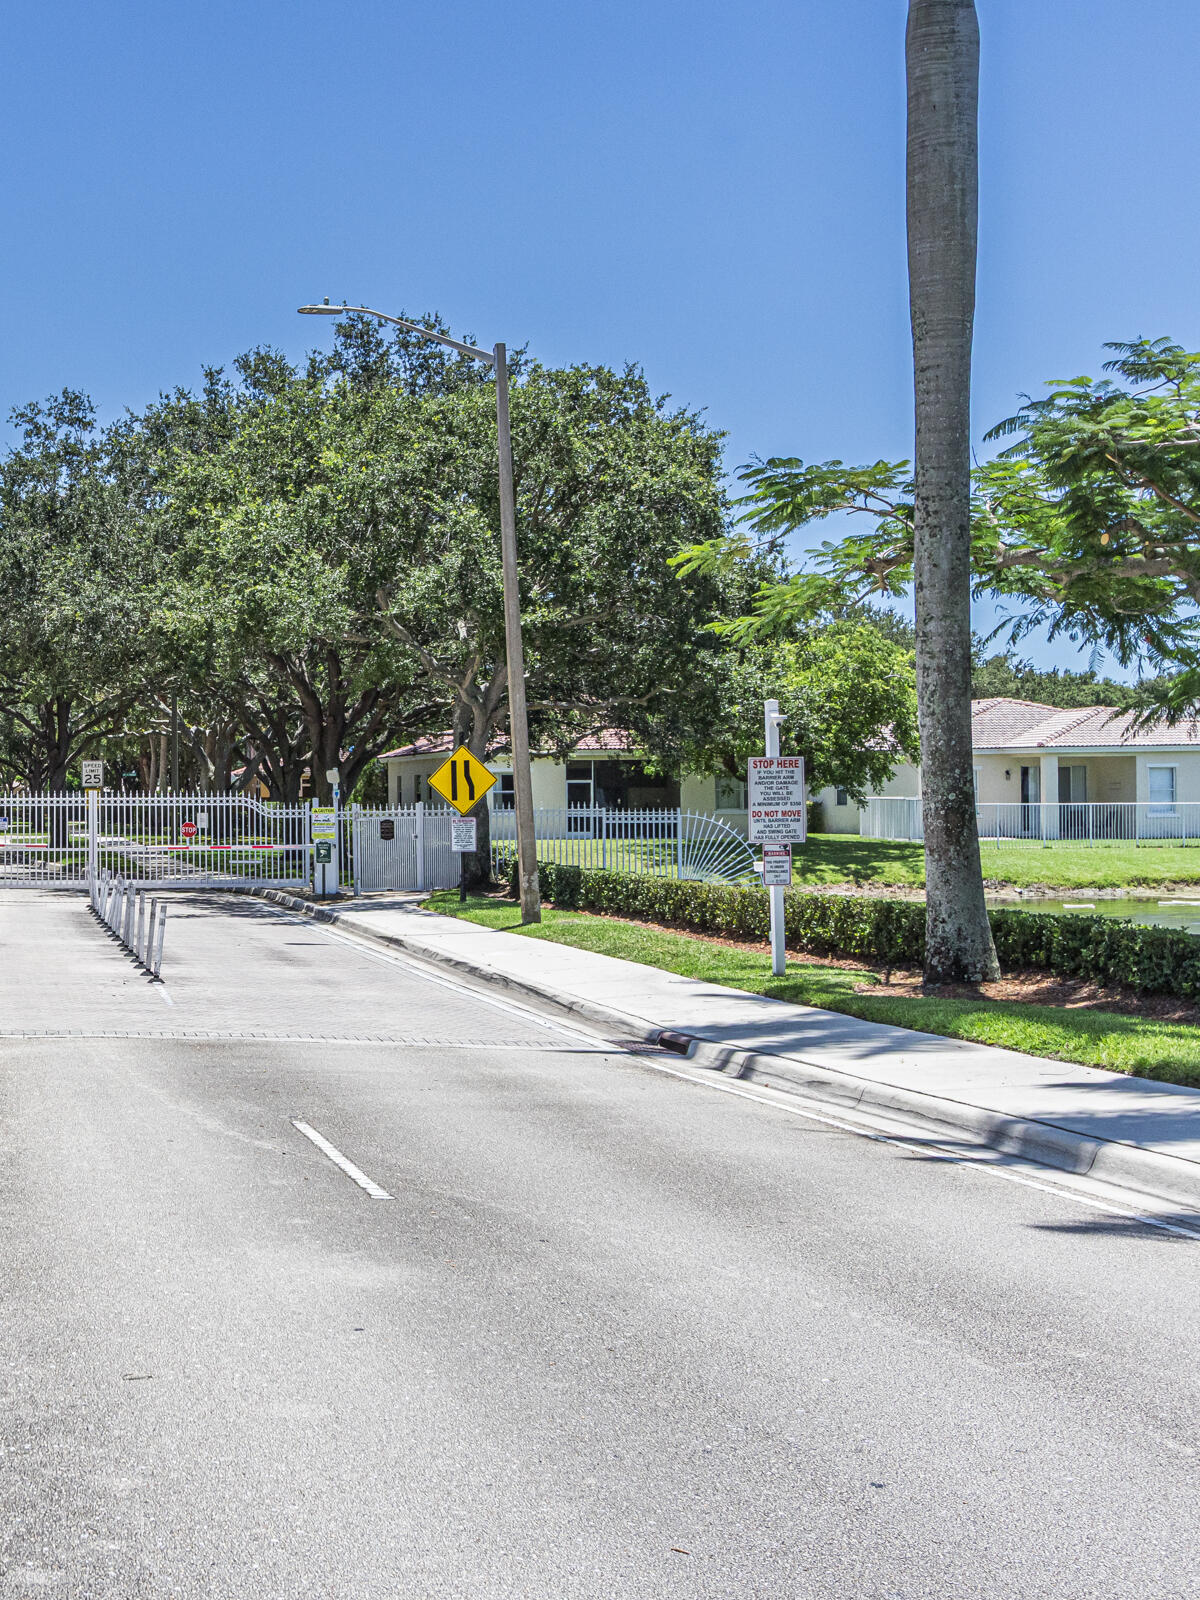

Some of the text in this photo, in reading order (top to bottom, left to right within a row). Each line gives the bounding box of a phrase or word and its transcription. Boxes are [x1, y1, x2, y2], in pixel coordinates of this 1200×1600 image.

[753, 760, 799, 768] STOP HERE
[85, 774, 101, 784] 25
